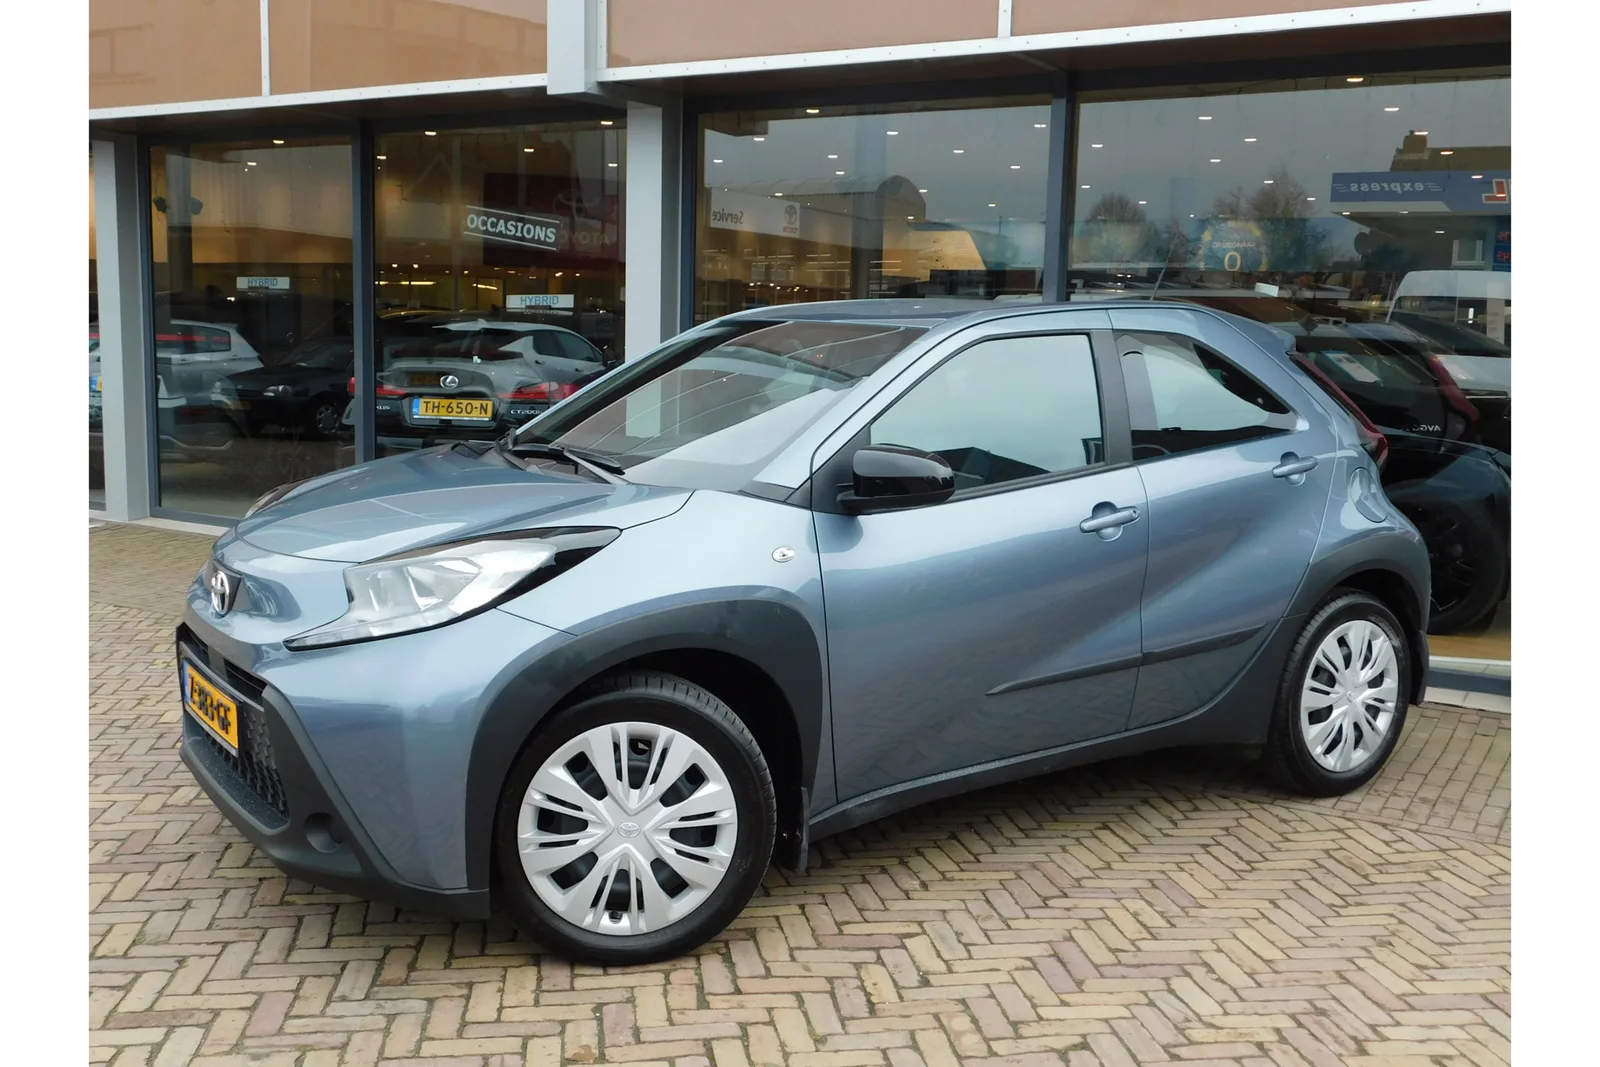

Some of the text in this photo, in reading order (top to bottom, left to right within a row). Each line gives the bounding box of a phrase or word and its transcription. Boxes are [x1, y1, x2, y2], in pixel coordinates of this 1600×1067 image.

[466, 213, 557, 243] OCCASIONS
[248, 277, 278, 287] HYBRID
[520, 295, 560, 306] HYBRID
[423, 400, 489, 416] TH-650-N
